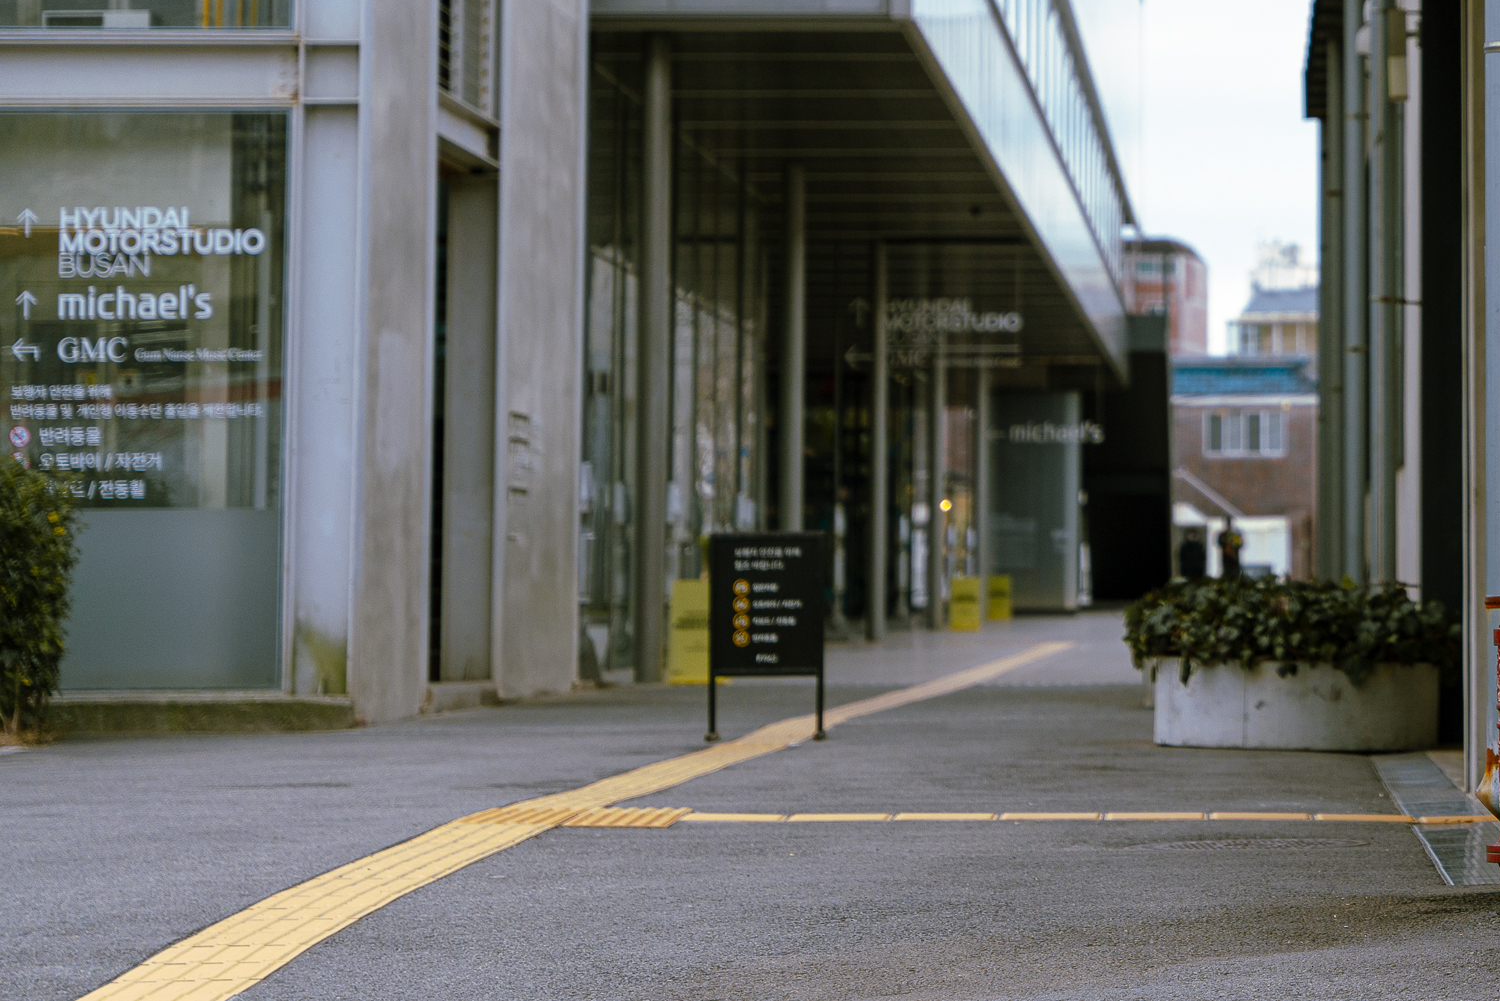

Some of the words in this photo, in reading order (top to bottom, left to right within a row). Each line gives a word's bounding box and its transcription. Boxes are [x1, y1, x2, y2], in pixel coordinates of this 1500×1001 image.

[59, 206, 191, 230] HYUNDAI
[58, 228, 267, 255] MOTORSTUDIO
[58, 252, 152, 279] BUSAN
[57, 284, 215, 320] michael's
[57, 336, 129, 363] GMC
[49, 384, 86, 401] 안전을
[10, 403, 57, 420] 반려동물
[39, 427, 102, 447] 반려동물
[39, 452, 102, 472] 오토바이
[115, 452, 163, 472] 자전거
